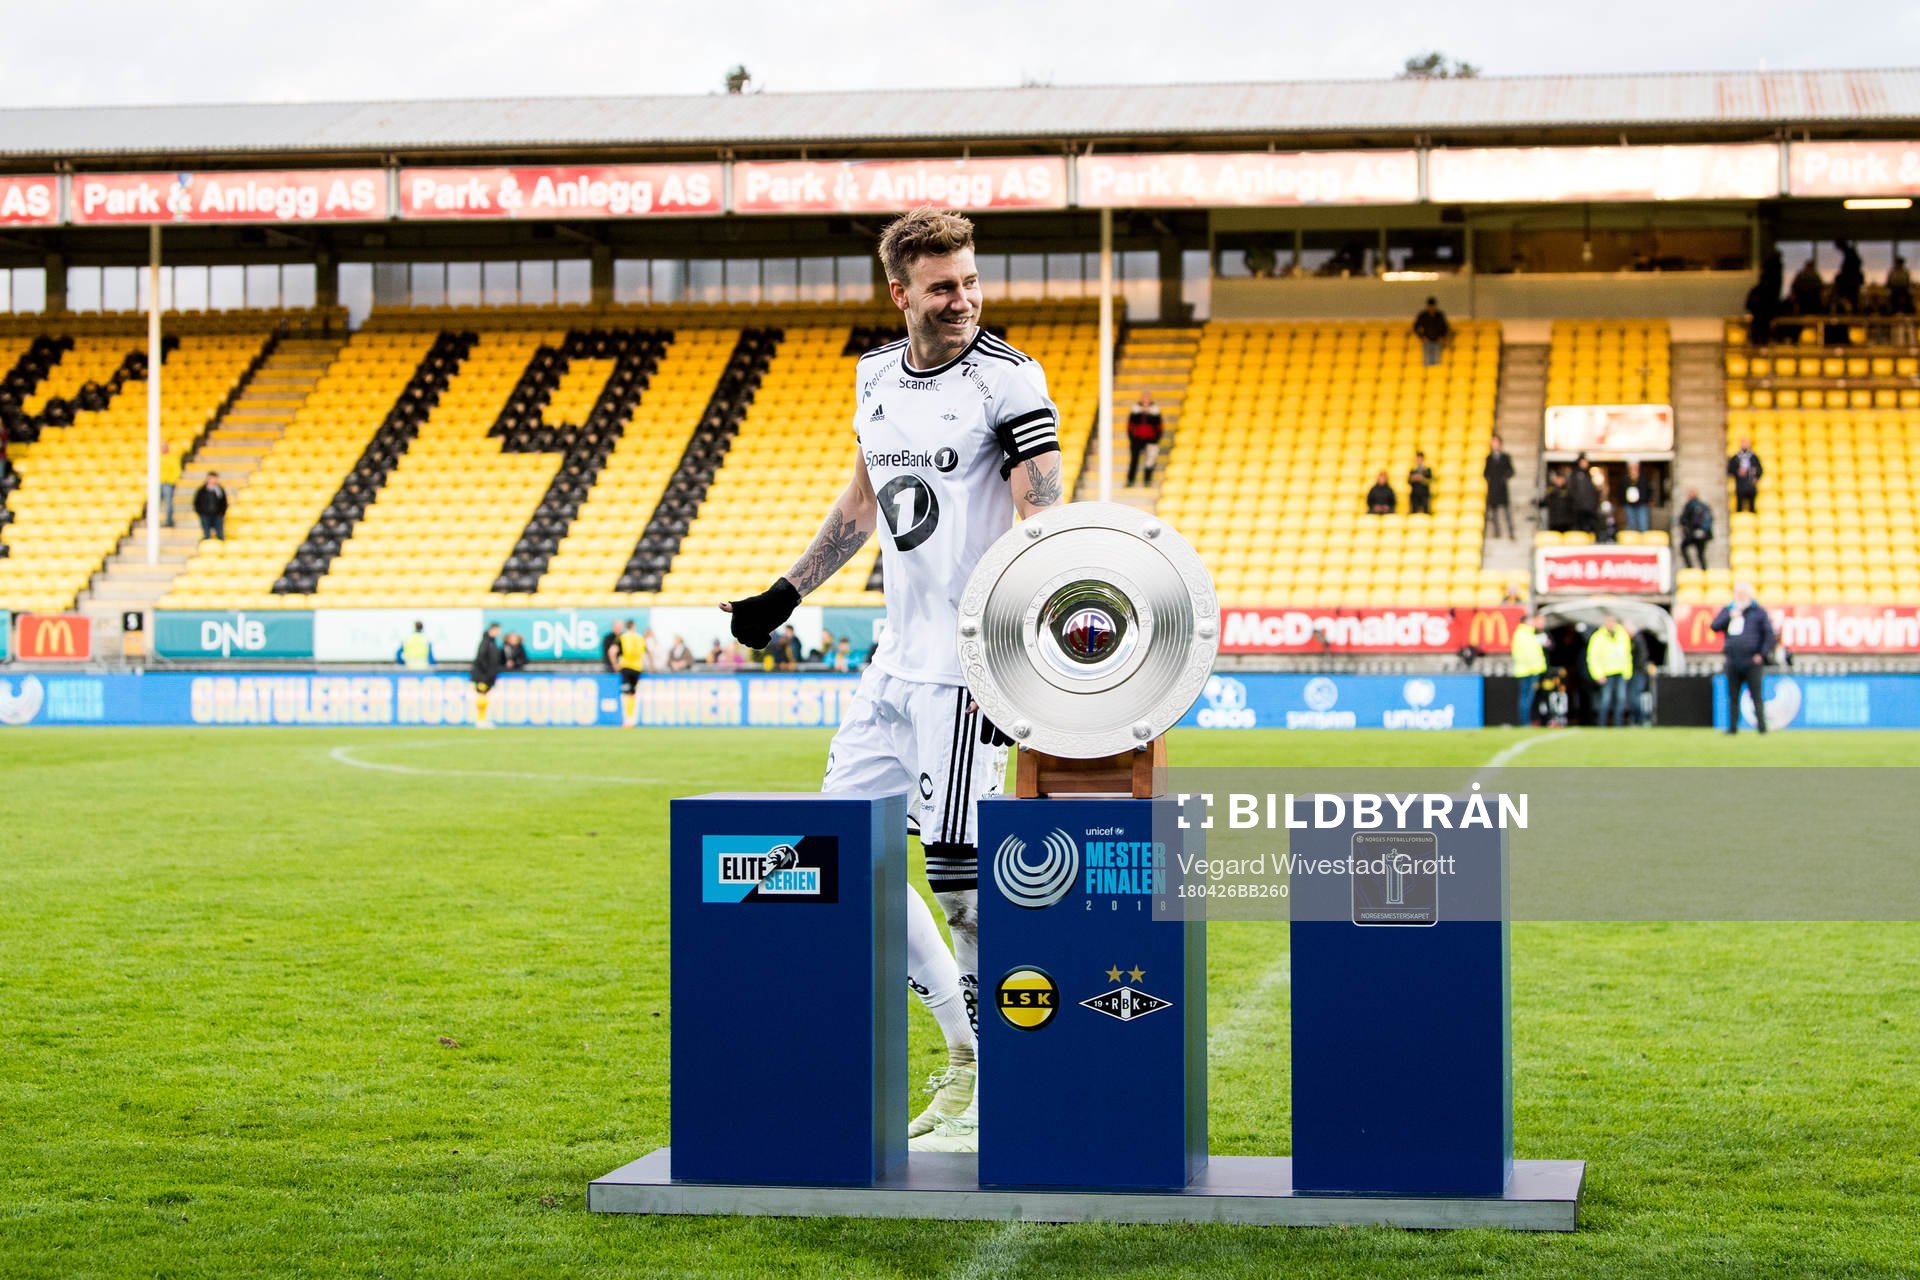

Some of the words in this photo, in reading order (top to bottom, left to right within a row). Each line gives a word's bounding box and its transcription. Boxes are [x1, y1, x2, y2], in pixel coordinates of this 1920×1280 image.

[1090, 164, 1172, 198] Park
[1804, 150, 1880, 186] Park
[1, 184, 50, 217] AS
[83, 180, 160, 214] Park
[165, 181, 193, 213] &
[199, 178, 320, 219] Anlegg
[325, 178, 377, 211] AS
[410, 176, 493, 211] Park
[497, 176, 525, 208] &
[531, 174, 652, 214] Anlegg
[658, 173, 712, 206] AS
[744, 170, 828, 203] Park
[833, 170, 861, 202] &
[865, 169, 993, 208] Anlegg
[1000, 166, 1053, 199] AS
[899, 377, 943, 391] Scandic
[865, 450, 934, 470] SpareBank
[201, 613, 267, 658] DNB
[532, 611, 600, 657] DNB
[191, 677, 393, 724] GRATULERER
[1085, 826, 1114, 836] unicef
[723, 857, 767, 881] ELITE
[1086, 842, 1167, 867] MESTER
[765, 871, 817, 890] SERIEN
[1086, 869, 1167, 894] FINALEN
[1003, 993, 1052, 1005] LSK
